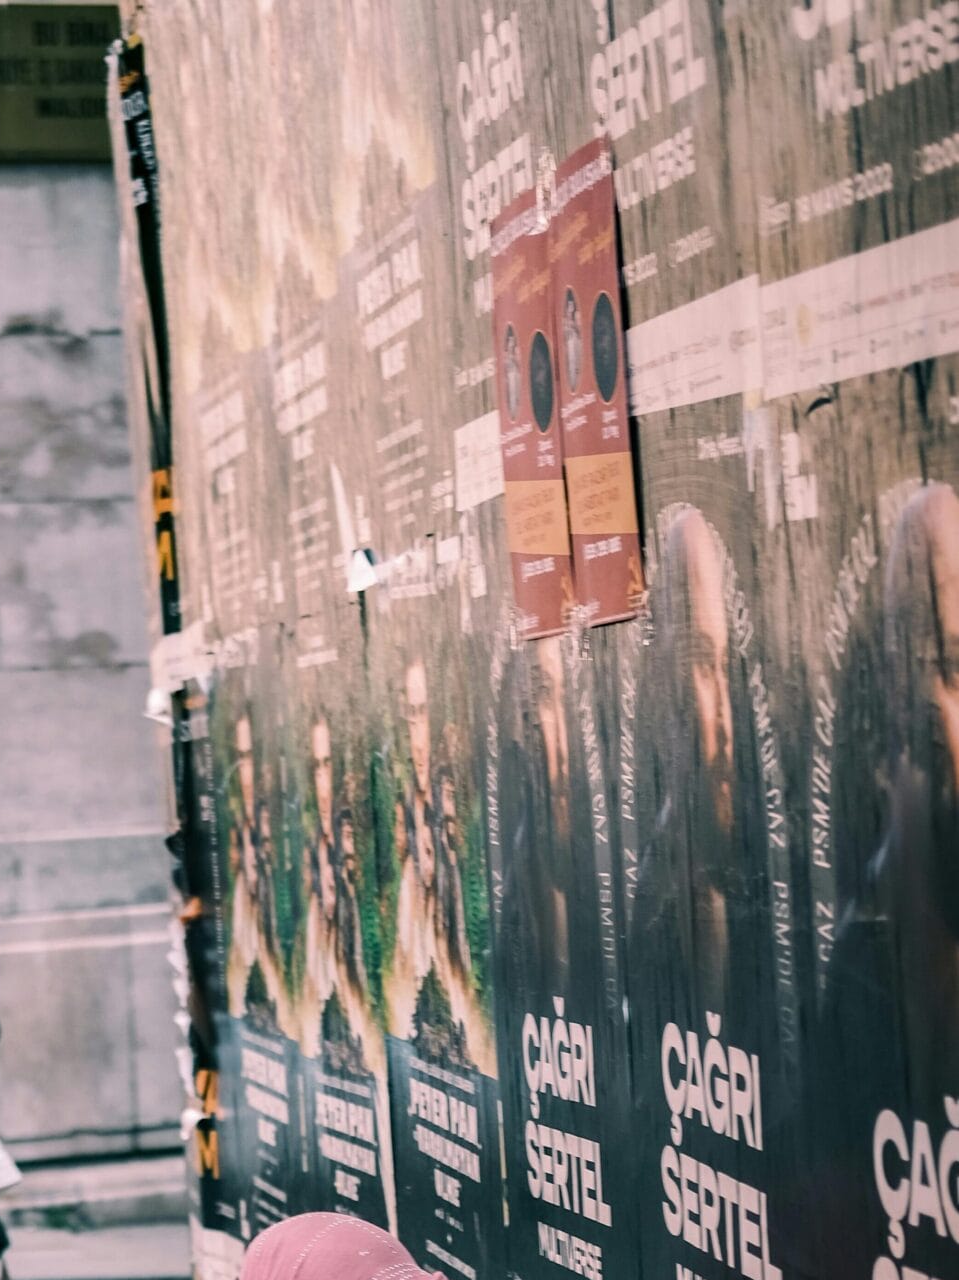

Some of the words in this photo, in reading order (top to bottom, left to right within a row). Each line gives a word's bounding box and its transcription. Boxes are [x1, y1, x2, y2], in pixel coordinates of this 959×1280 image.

[590, 0, 707, 141] SERTEL
[522, 996, 596, 1119] ÇAĞRI
[661, 1011, 763, 1151] ÇAĞRI
[525, 1120, 612, 1228] SERTEL
